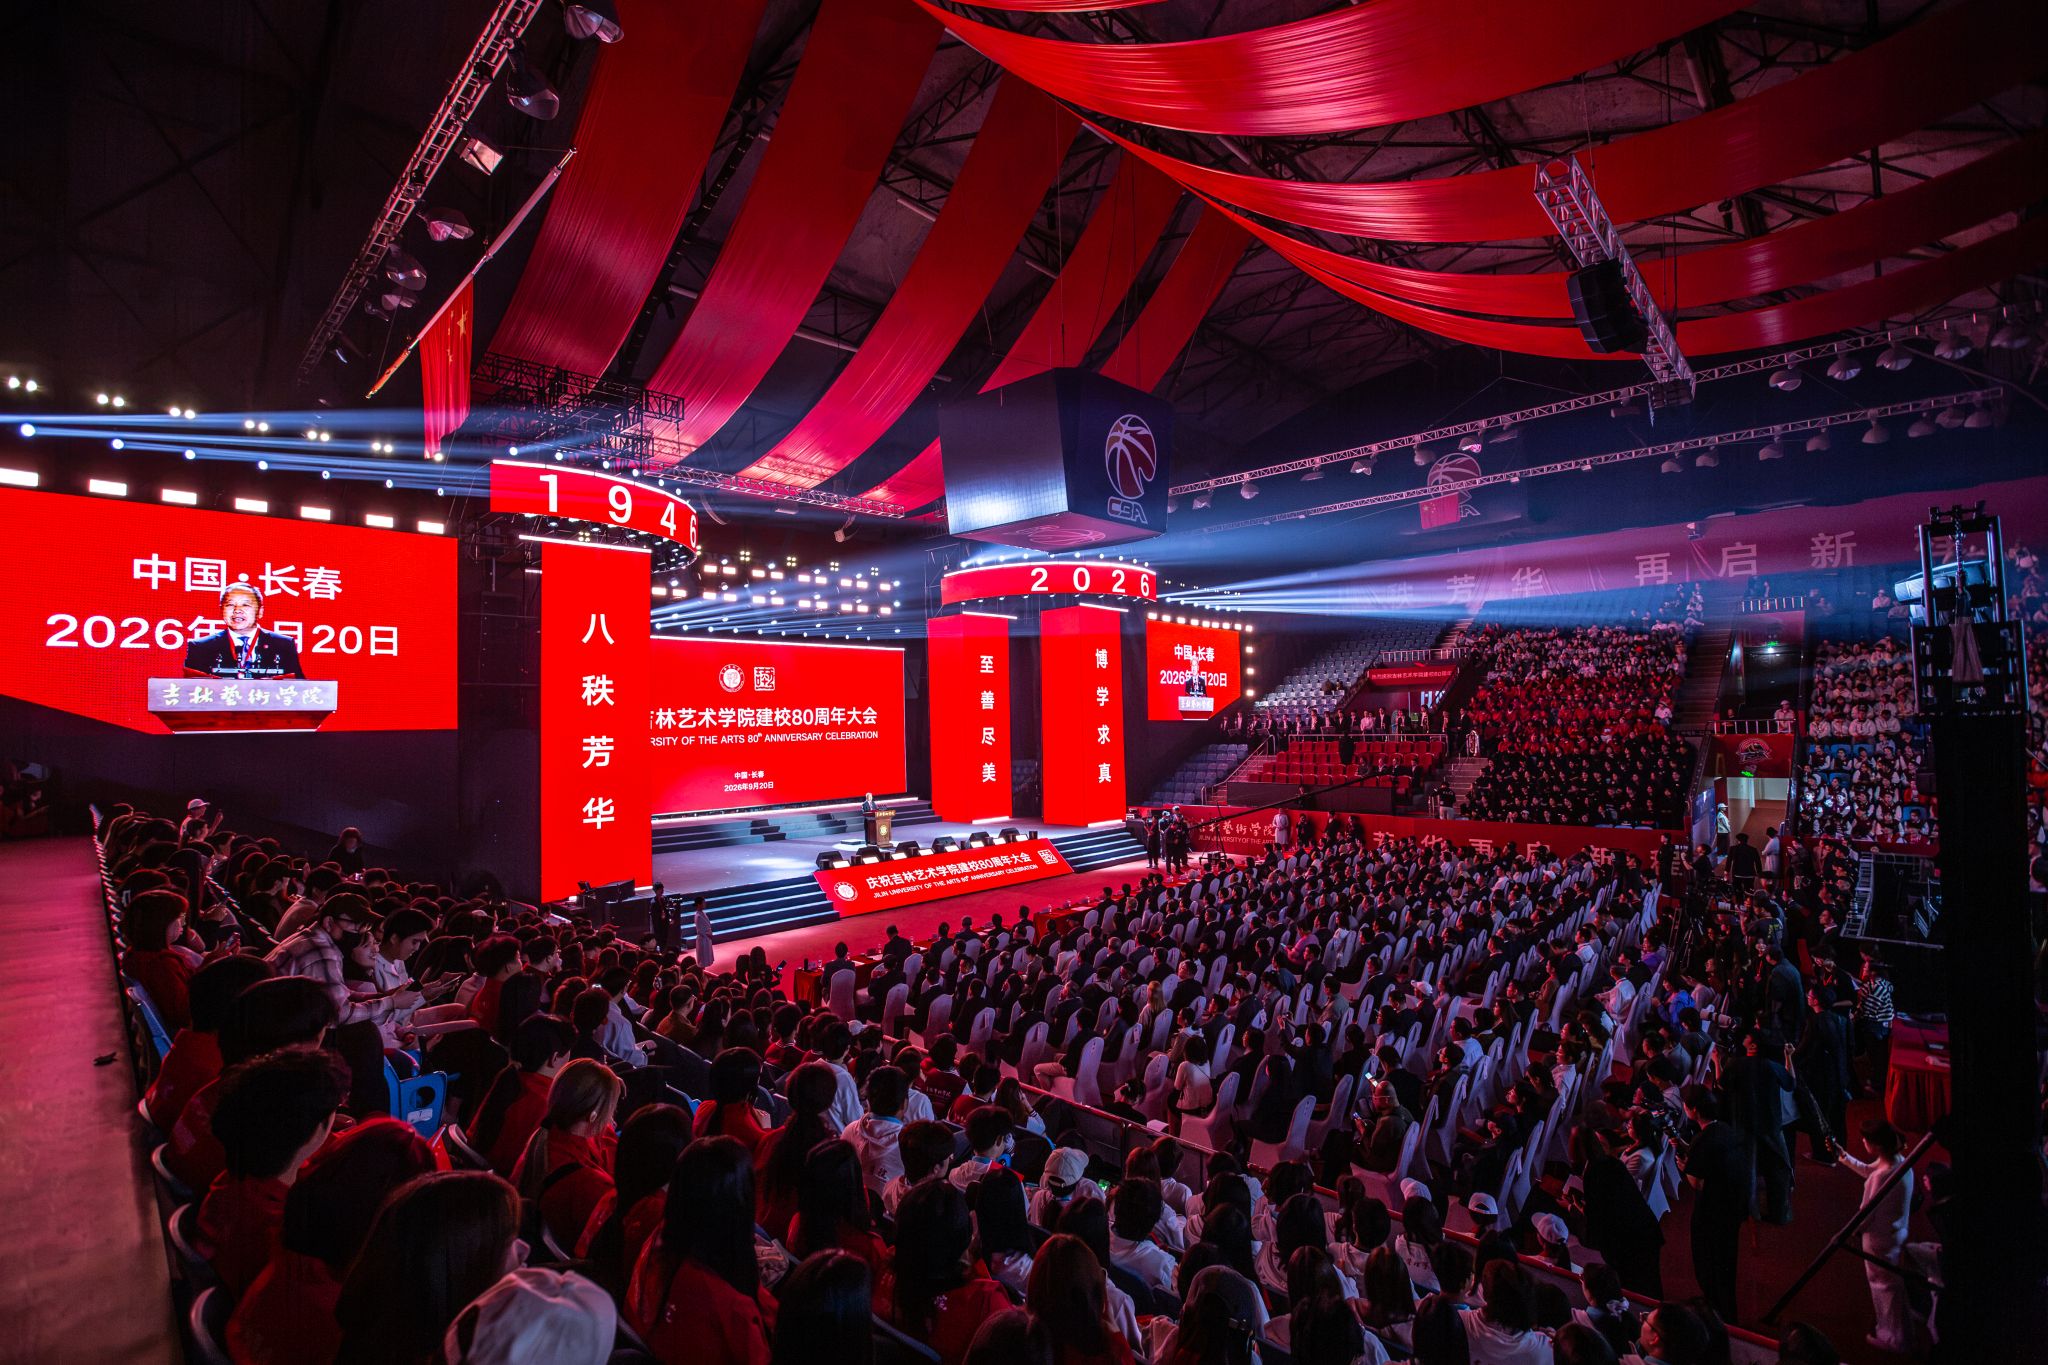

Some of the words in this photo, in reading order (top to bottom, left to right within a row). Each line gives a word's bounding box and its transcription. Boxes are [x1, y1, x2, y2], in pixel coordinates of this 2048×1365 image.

[540, 474, 698, 549] 1946
[1106, 496, 1149, 525] CBA
[1030, 567, 1150, 597] 2026
[46, 613, 398, 657] 2026年月20日
[1159, 669, 1227, 687] 2026年月20日
[581, 613, 615, 830] 八秩芳华
[650, 706, 878, 730] 林艺术学院建校80周年大会
[979, 655, 996, 783] 至善尽美
[1096, 648, 1112, 784] 博学求真
[681, 735, 696, 746] OF
[698, 735, 718, 745] THE
[720, 734, 745, 744] ARTS
[764, 732, 823, 742] ANNIVERSARY
[825, 730, 879, 740] CELEBRATION
[724, 781, 774, 792] 2026年9月20日
[866, 852, 1032, 890] 庆祝吉林艺术学院建校80周年大会
[889, 884, 923, 896] UNIVERSITY
